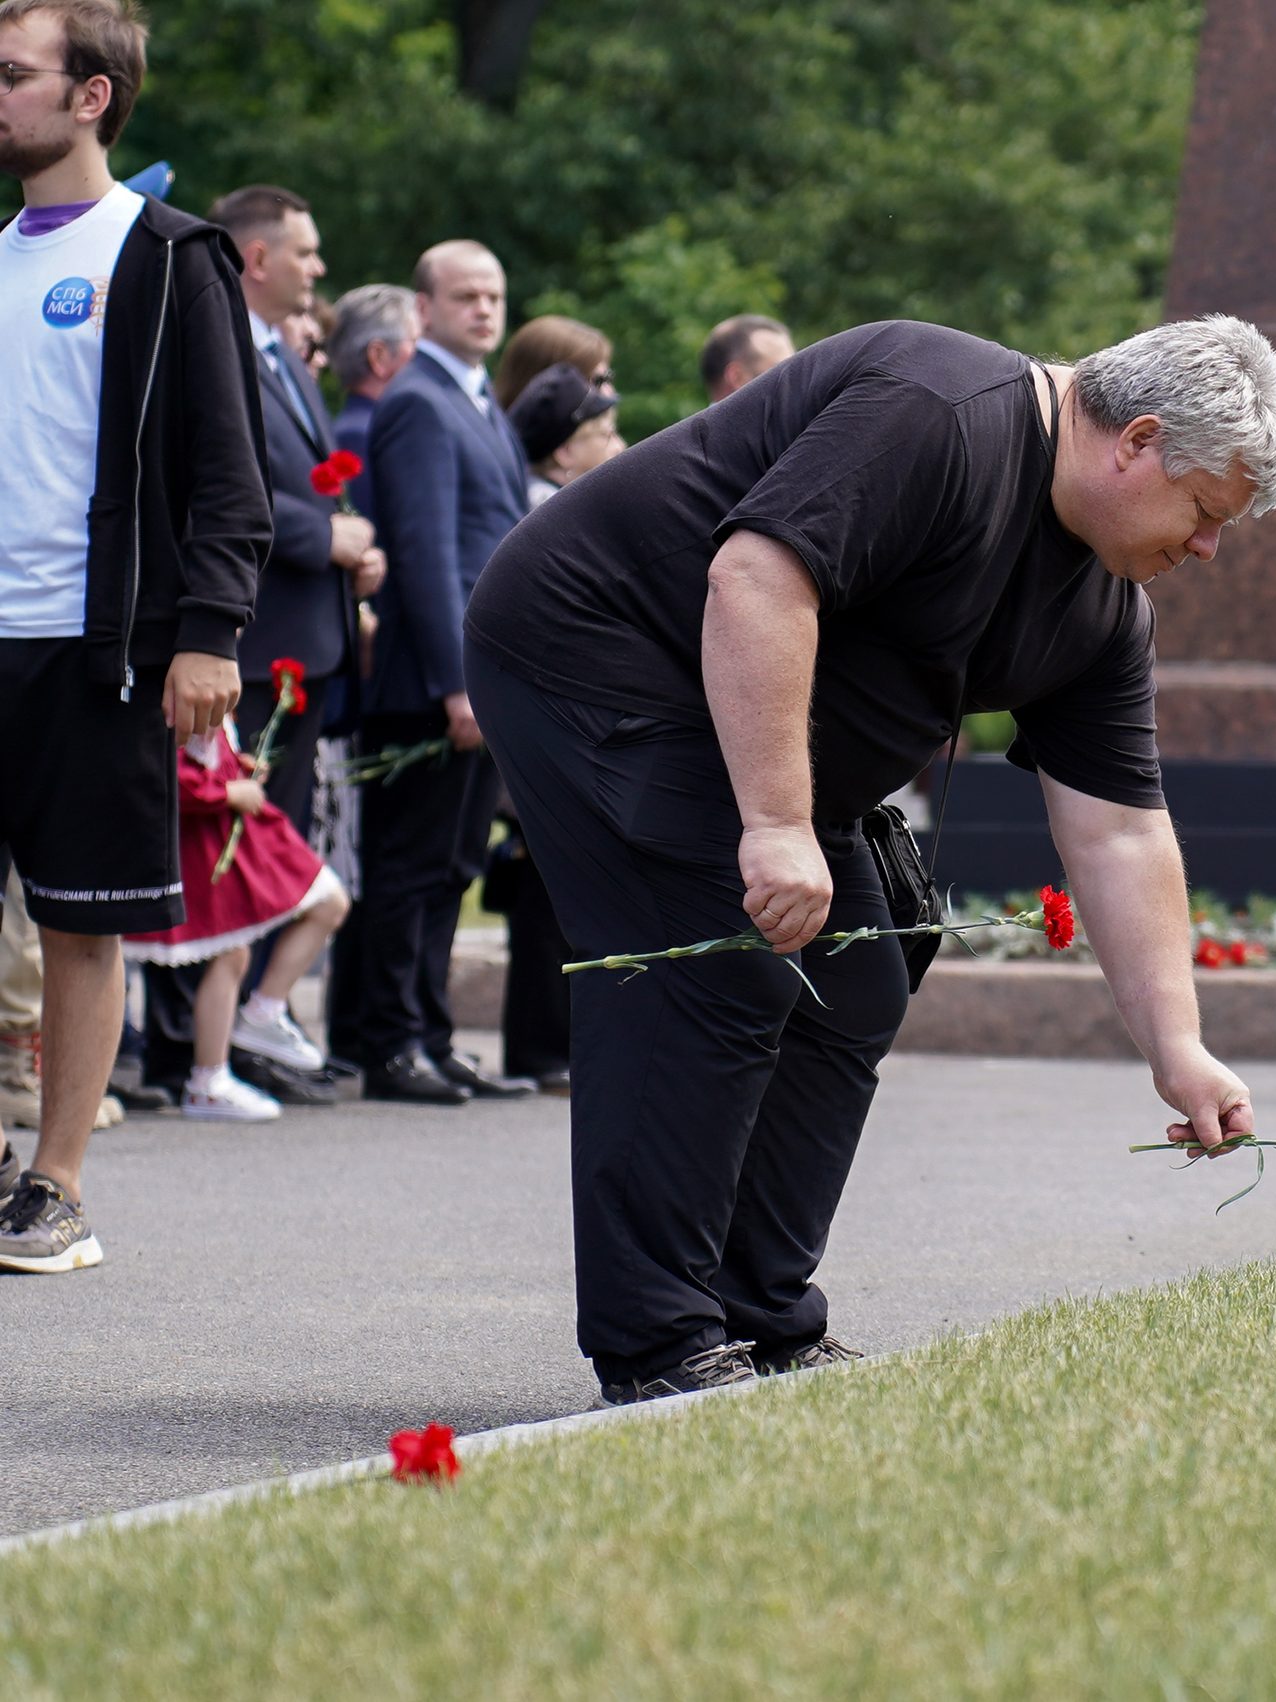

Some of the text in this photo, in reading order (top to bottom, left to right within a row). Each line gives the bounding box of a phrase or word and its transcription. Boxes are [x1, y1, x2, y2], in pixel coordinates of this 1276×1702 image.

[46, 300, 84, 316] МСИ
[63, 889, 95, 902] CHANGE
[95, 889, 110, 902] THE
[110, 888, 134, 901] RULES
